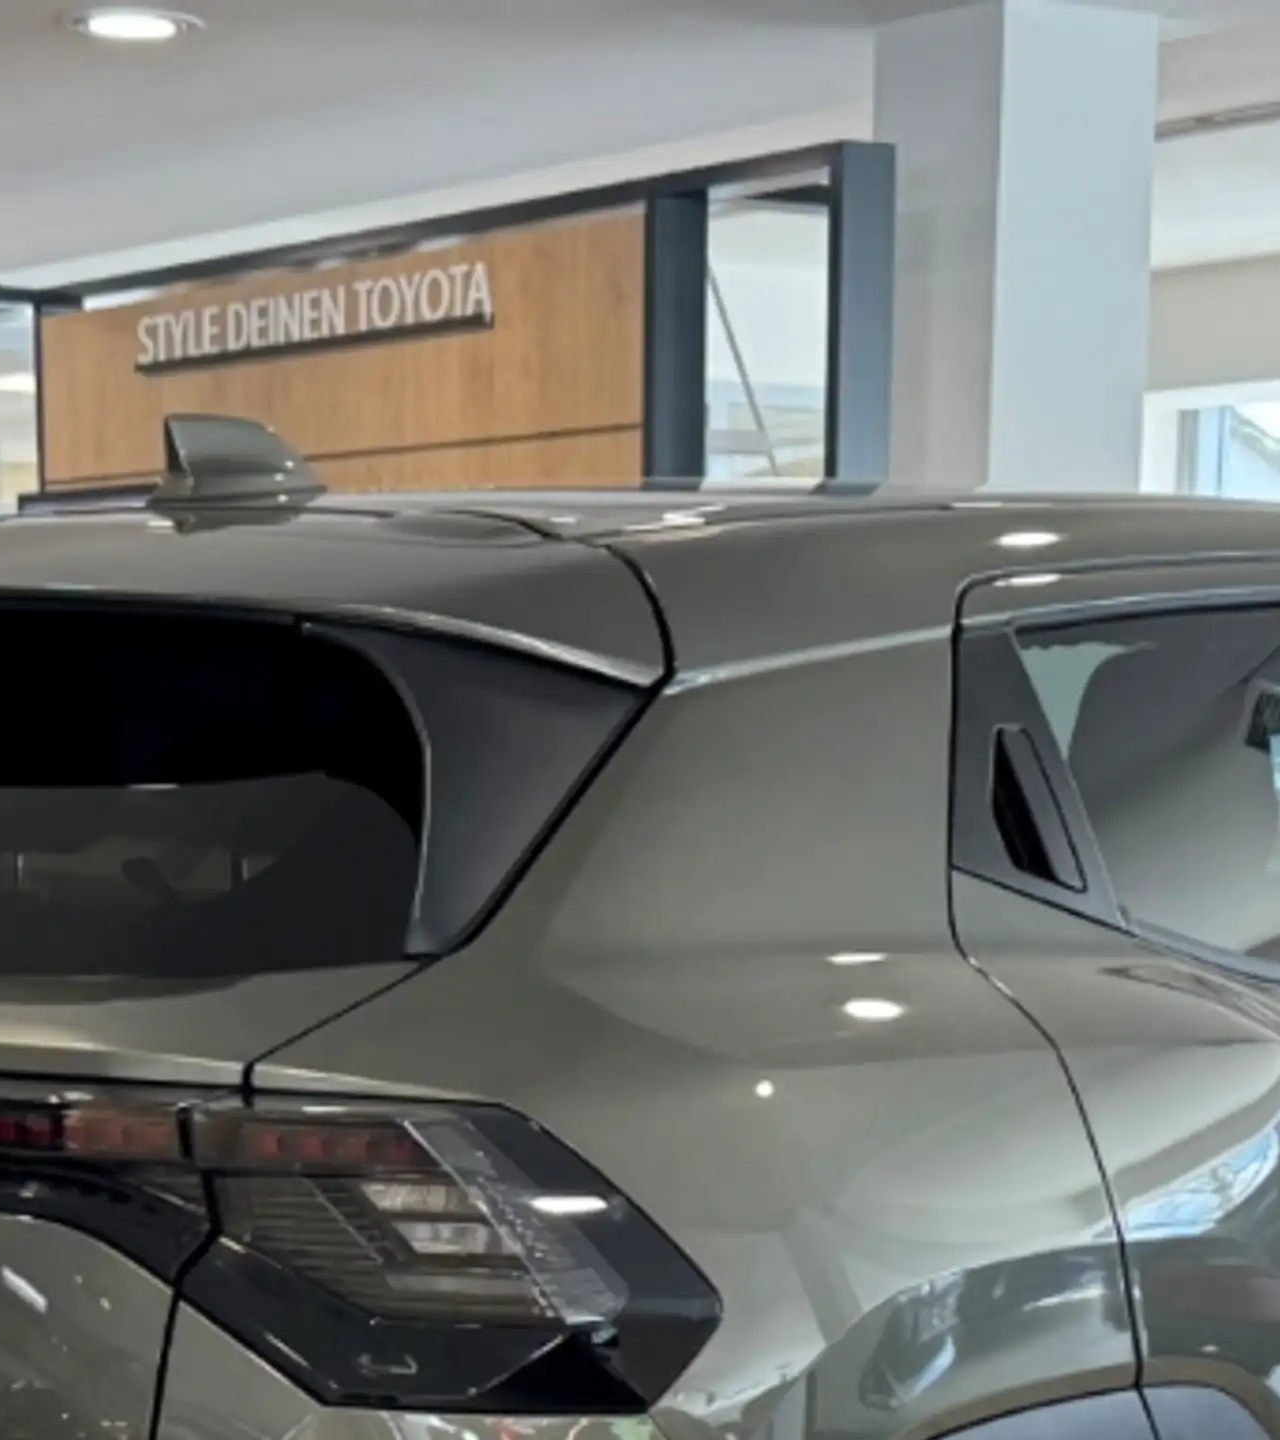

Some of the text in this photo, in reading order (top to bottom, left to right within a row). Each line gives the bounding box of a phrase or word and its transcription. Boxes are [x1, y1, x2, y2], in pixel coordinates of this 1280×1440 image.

[136, 261, 493, 365] STYLE DEINEN TOYOTA
